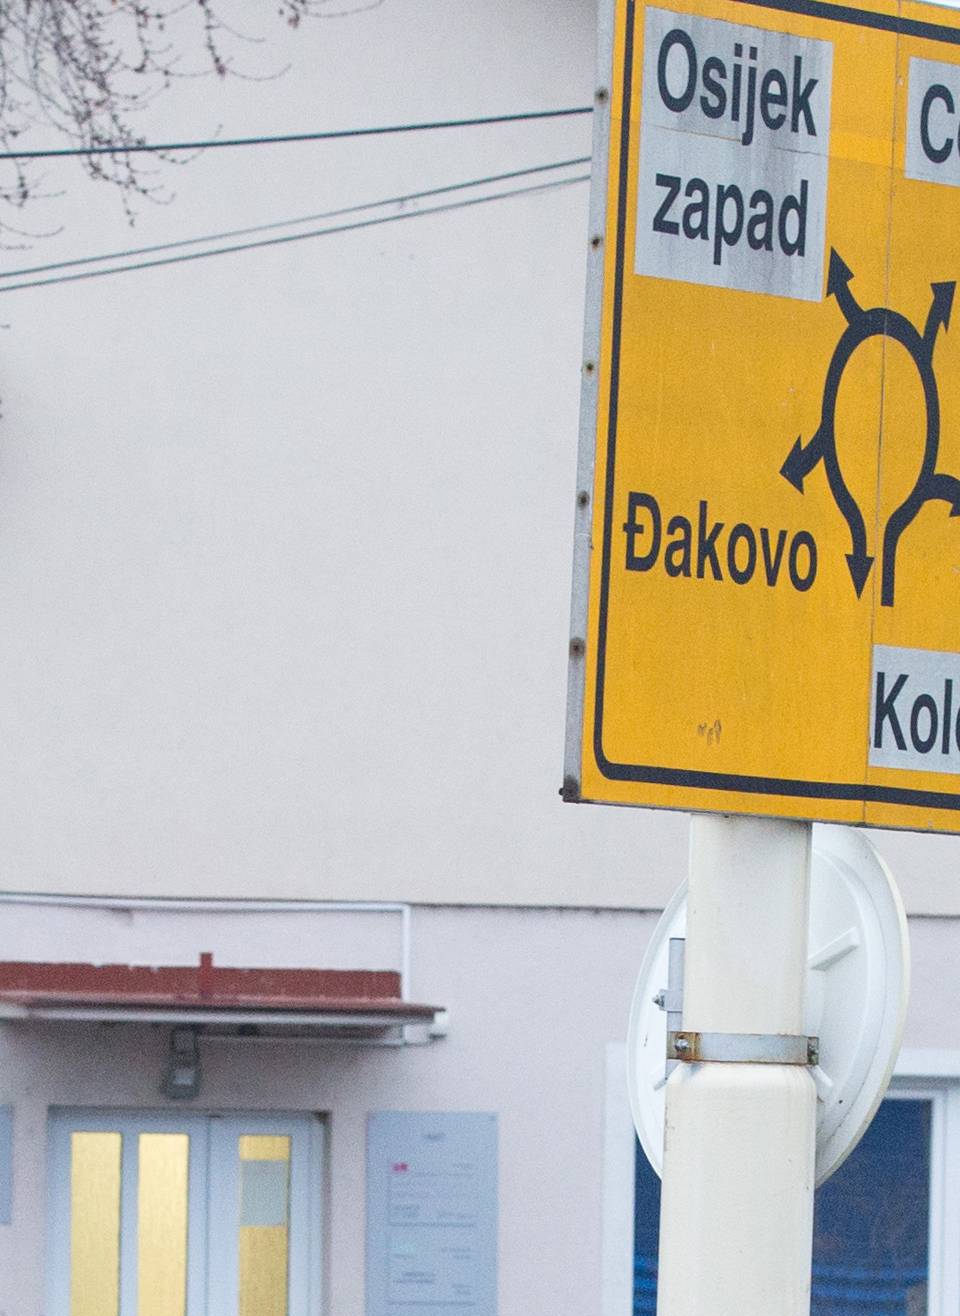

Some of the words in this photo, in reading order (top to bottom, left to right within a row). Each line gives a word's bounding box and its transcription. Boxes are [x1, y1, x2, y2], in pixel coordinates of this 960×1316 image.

[657, 28, 819, 146] Osijek
[651, 172, 809, 265] zapad
[622, 491, 818, 592] Đakovo
